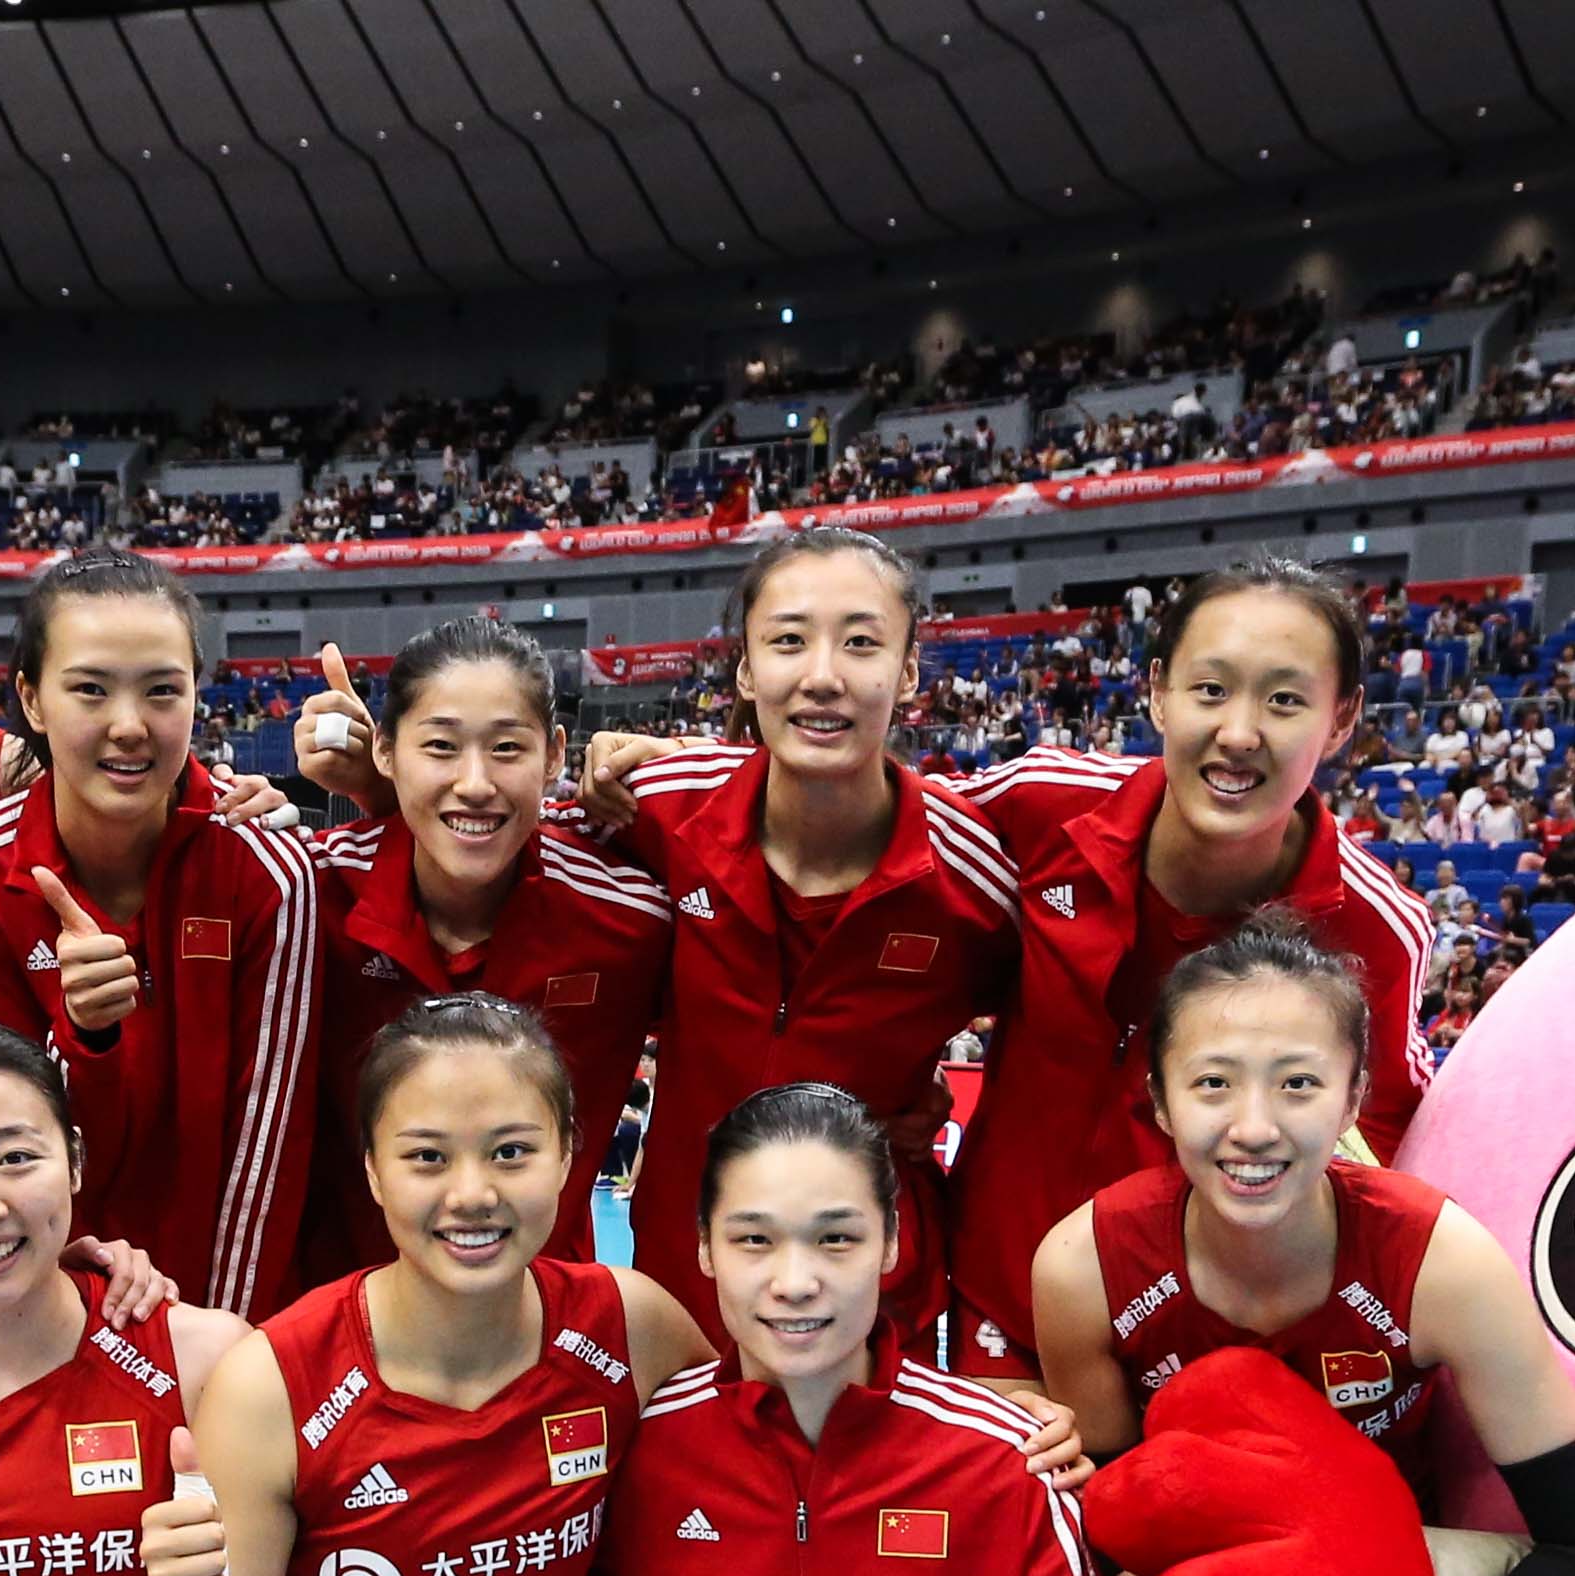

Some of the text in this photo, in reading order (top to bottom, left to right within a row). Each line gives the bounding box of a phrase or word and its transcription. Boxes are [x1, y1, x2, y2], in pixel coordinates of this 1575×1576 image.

[678, 900, 715, 920] adidas
[1042, 889, 1077, 920] adidas
[1113, 1272, 1181, 1340] 腾讯体育
[1338, 1281, 1409, 1348] 腾讯体育
[90, 1325, 178, 1398] 腾讯体育
[553, 1328, 631, 1385] 腾讯体育
[1336, 1383, 1385, 1402] CHN
[300, 1366, 371, 1450] 腾讯体育
[80, 1466, 134, 1487] CHN
[558, 1454, 602, 1477] CHN
[344, 1487, 409, 1510] adidas
[676, 1528, 721, 1541] adidas
